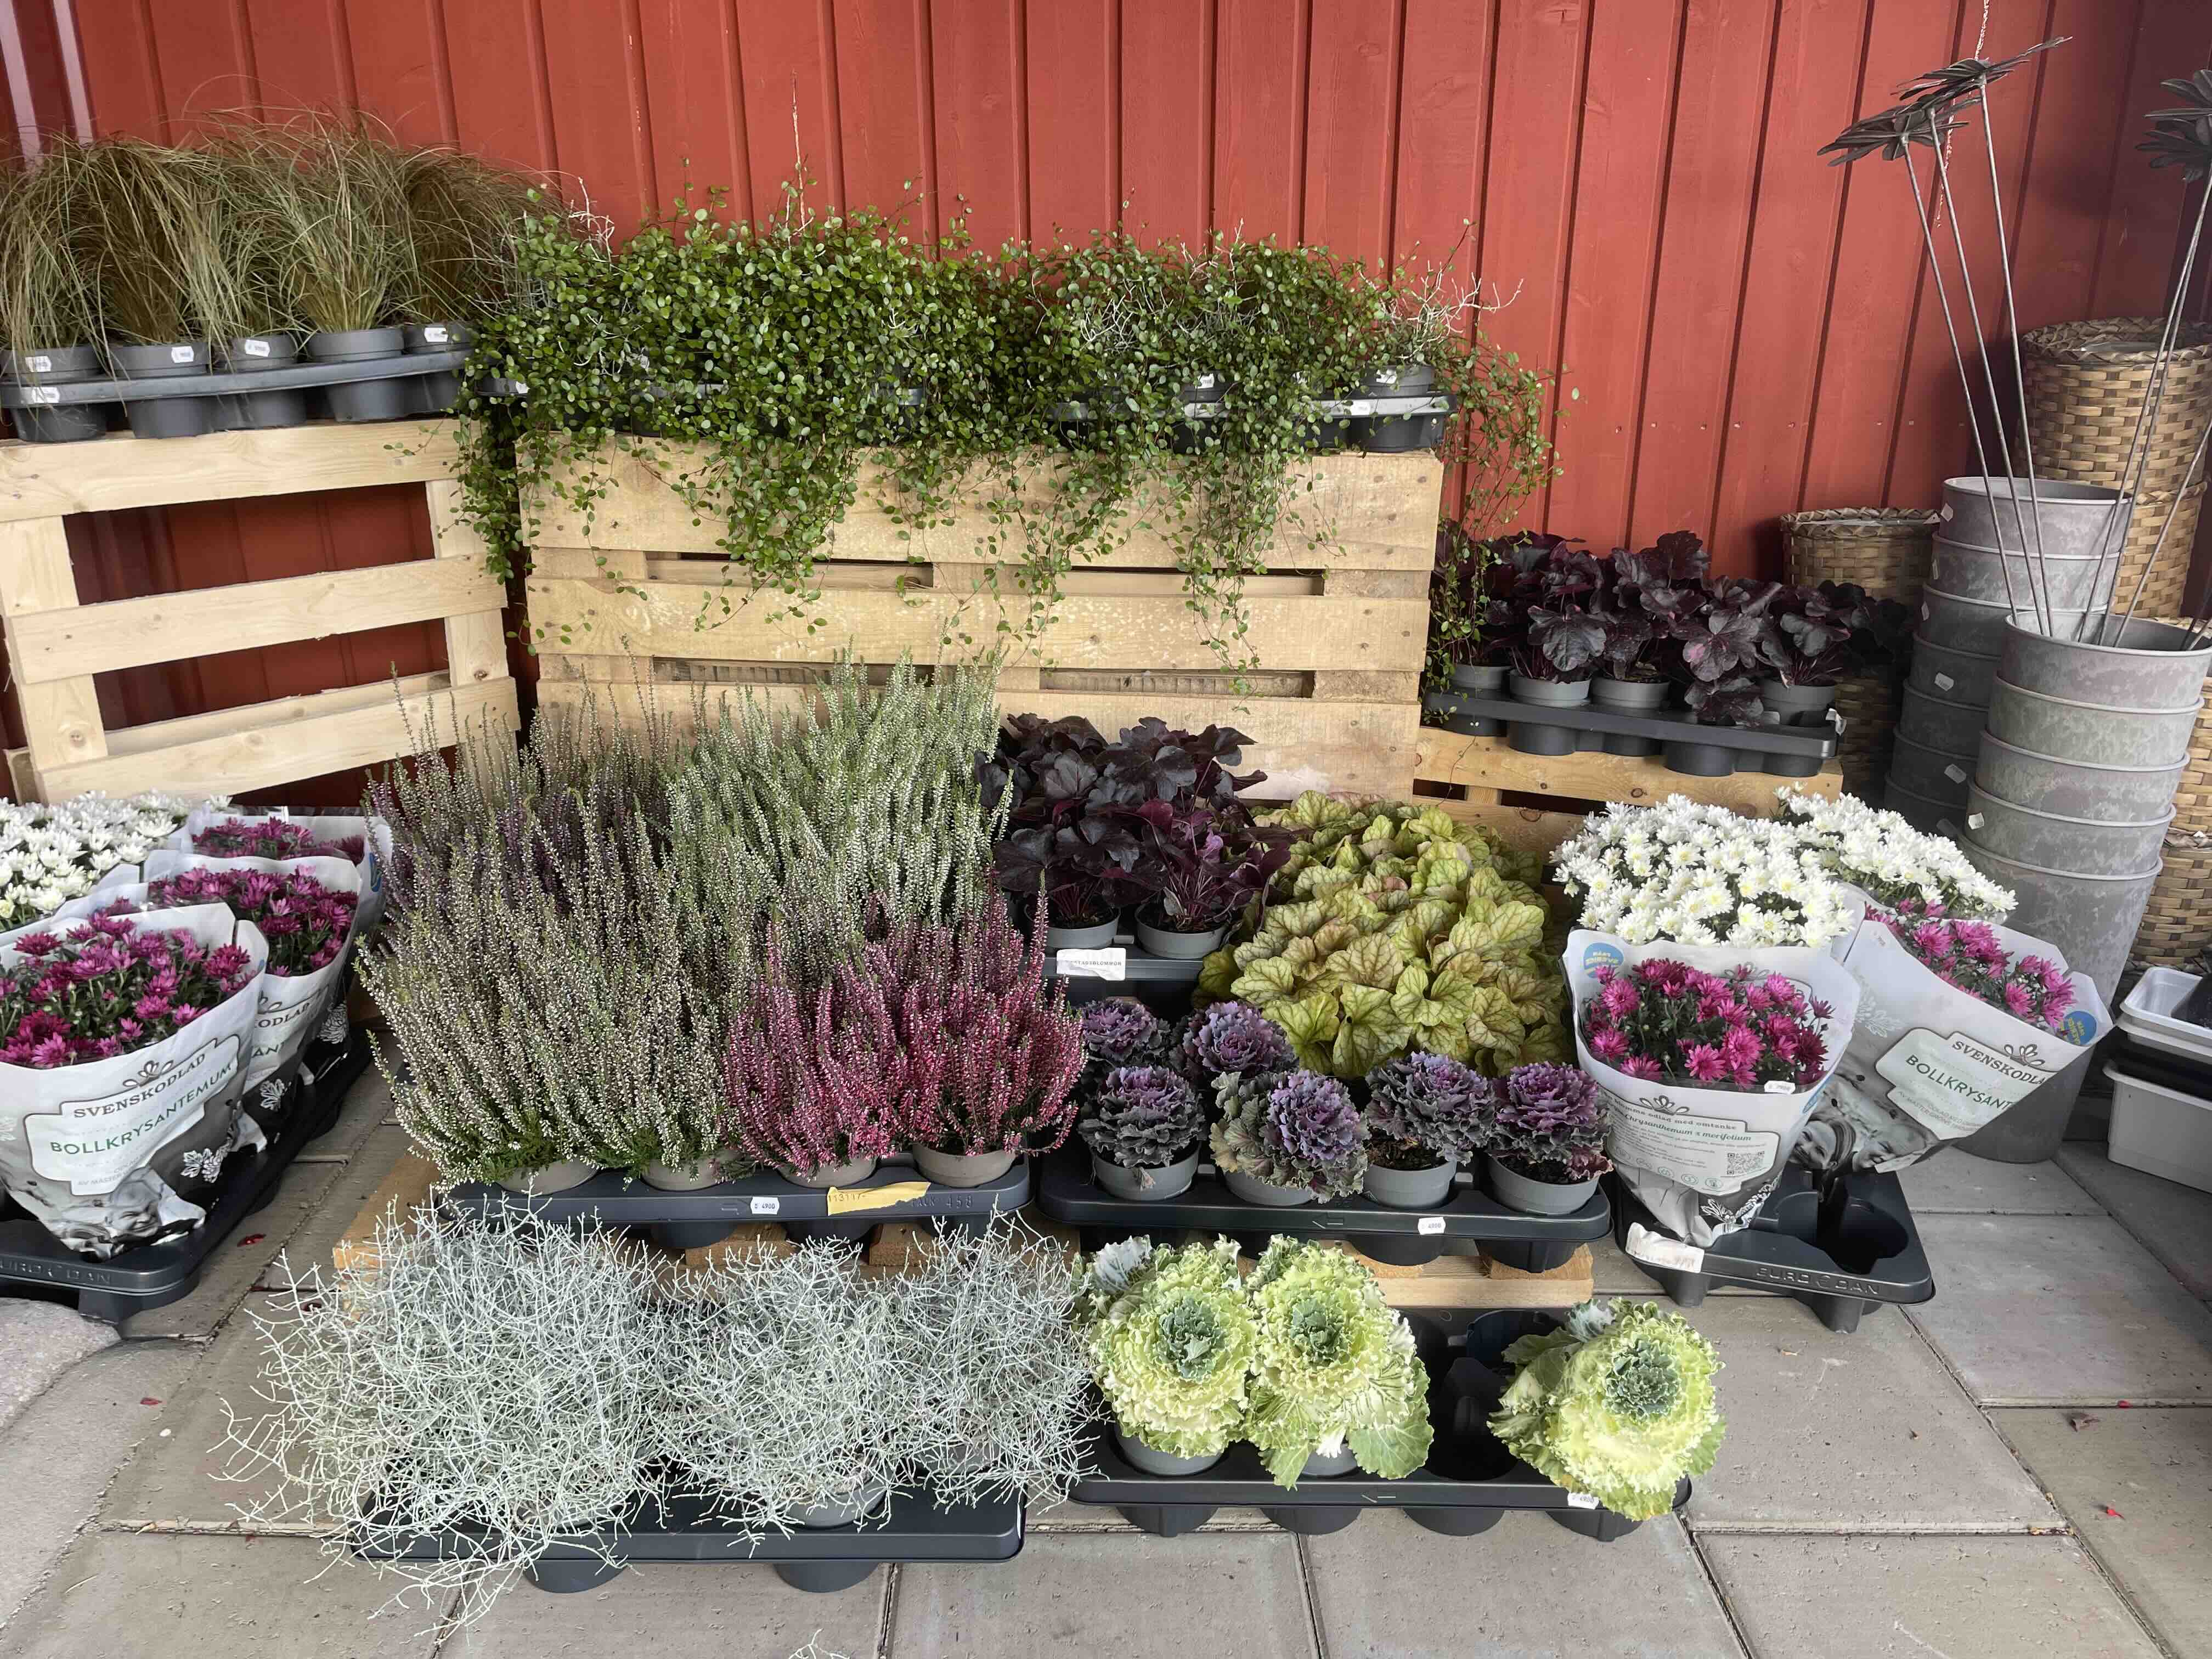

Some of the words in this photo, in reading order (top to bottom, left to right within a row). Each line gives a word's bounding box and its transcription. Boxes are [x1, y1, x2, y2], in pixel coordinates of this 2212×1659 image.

[74, 1053, 206, 1119] SVENSKODLAD
[50, 1062, 232, 1155] BOLLKRYSANTEMUM
[1624, 1114, 1693, 1136] Chrysanthemum
[1756, 1267, 1809, 1284] EURO
